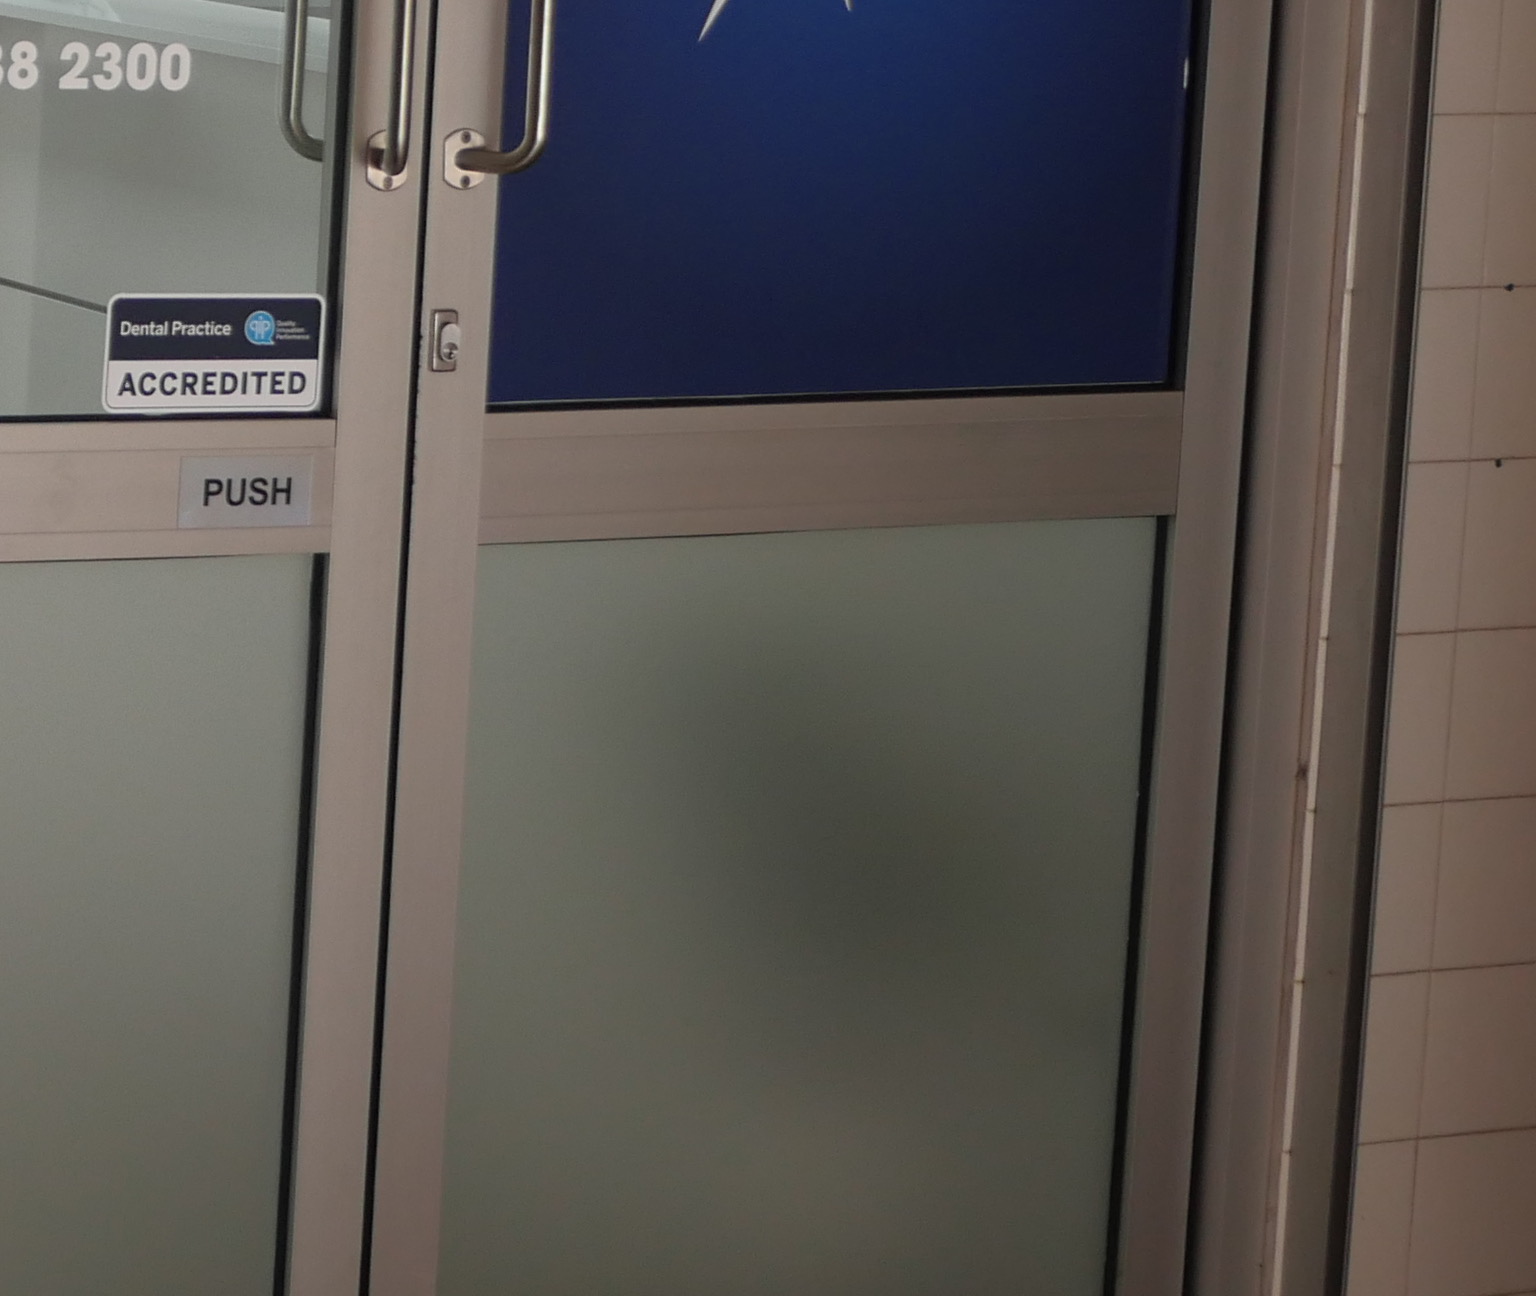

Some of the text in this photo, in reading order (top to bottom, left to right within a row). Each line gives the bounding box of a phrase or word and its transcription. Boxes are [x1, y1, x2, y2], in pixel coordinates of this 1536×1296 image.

[58, 42, 192, 92] 2300
[120, 321, 232, 336] Dental Practice
[117, 372, 306, 396] ACCREDITED
[203, 477, 292, 506] PUSH
